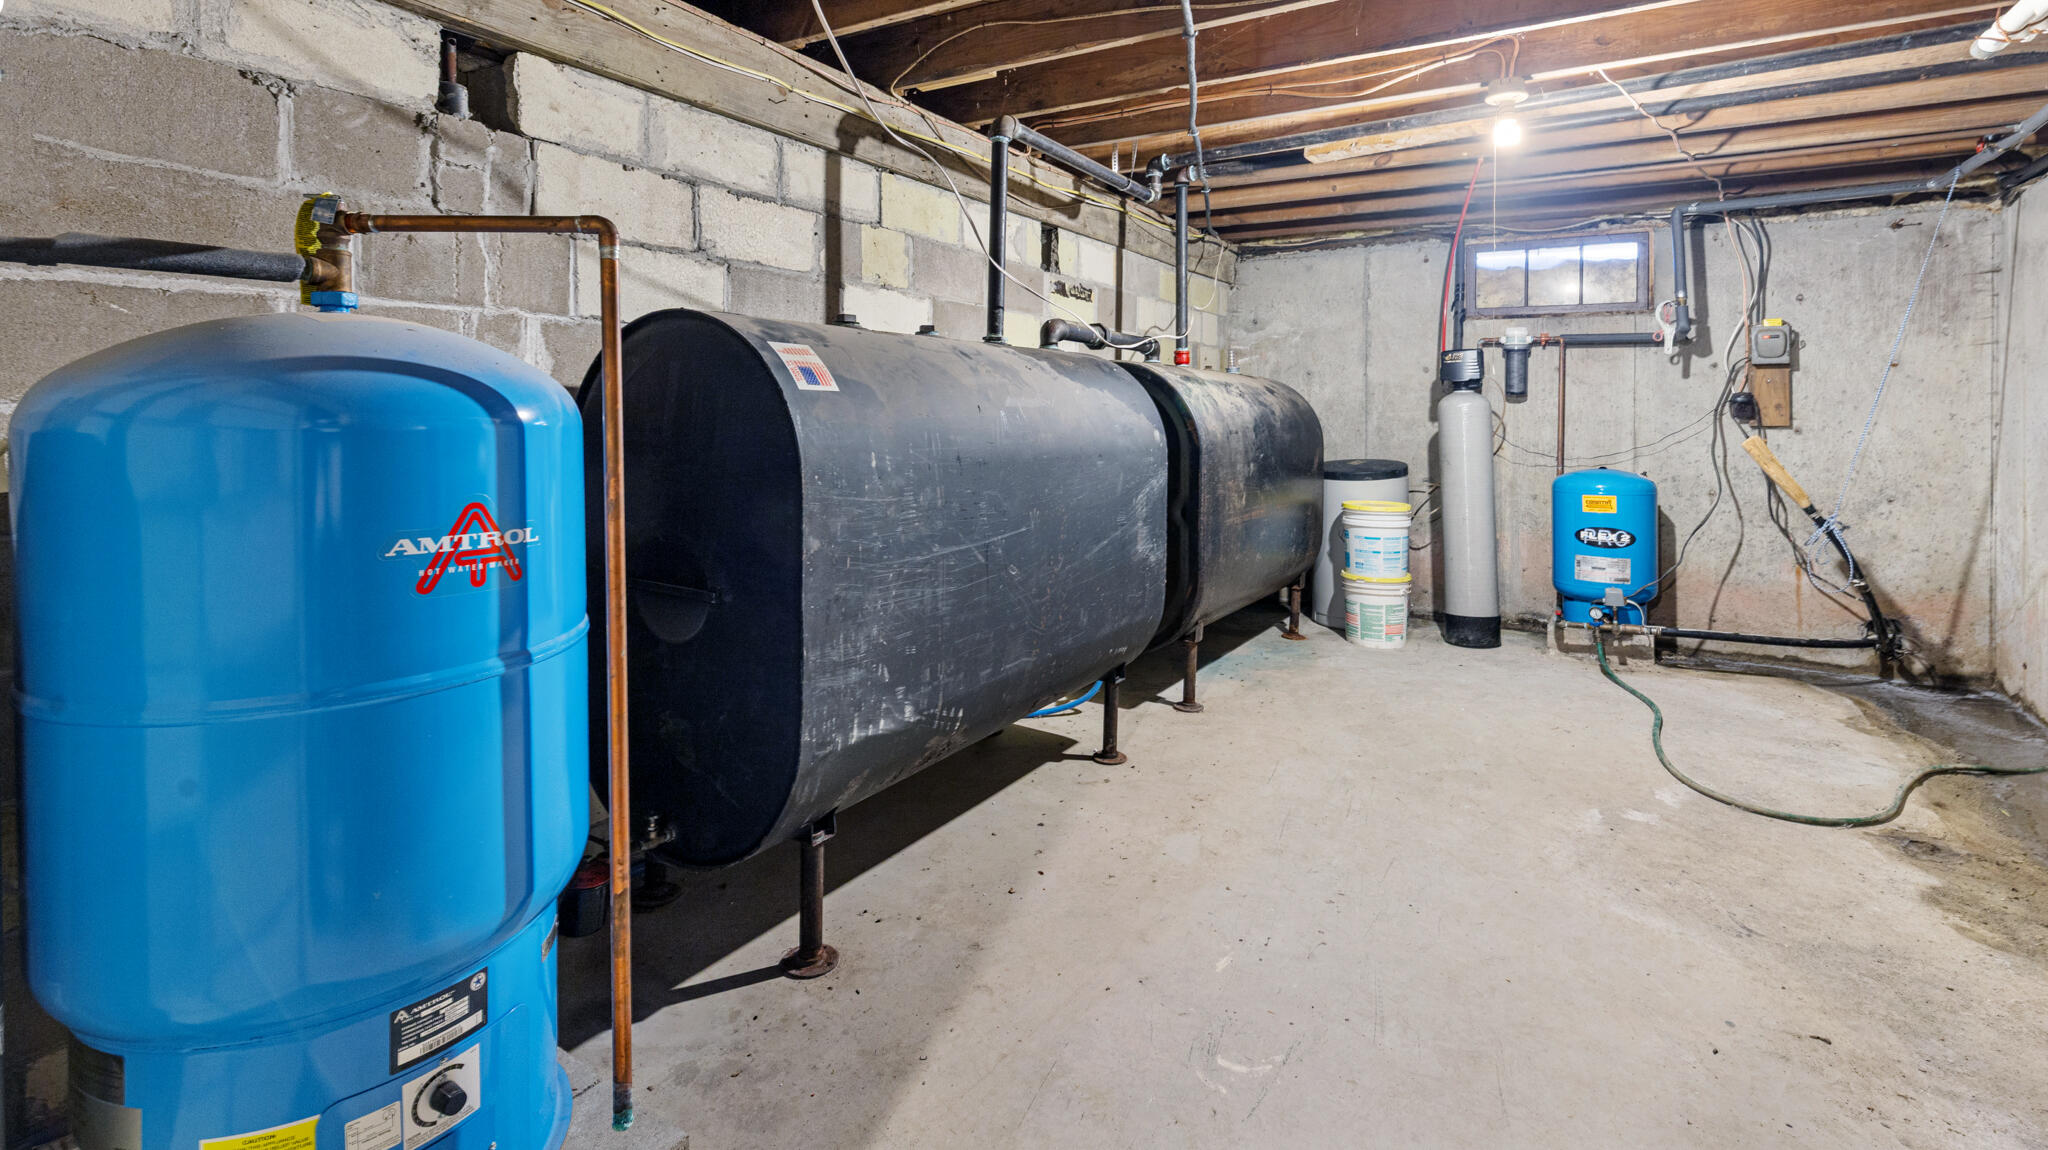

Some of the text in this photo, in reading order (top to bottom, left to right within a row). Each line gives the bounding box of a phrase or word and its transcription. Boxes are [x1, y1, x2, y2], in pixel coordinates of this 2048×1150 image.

[384, 527, 539, 557] AMTROL
[418, 567, 442, 577] HOT
[448, 562, 484, 574] WATER
